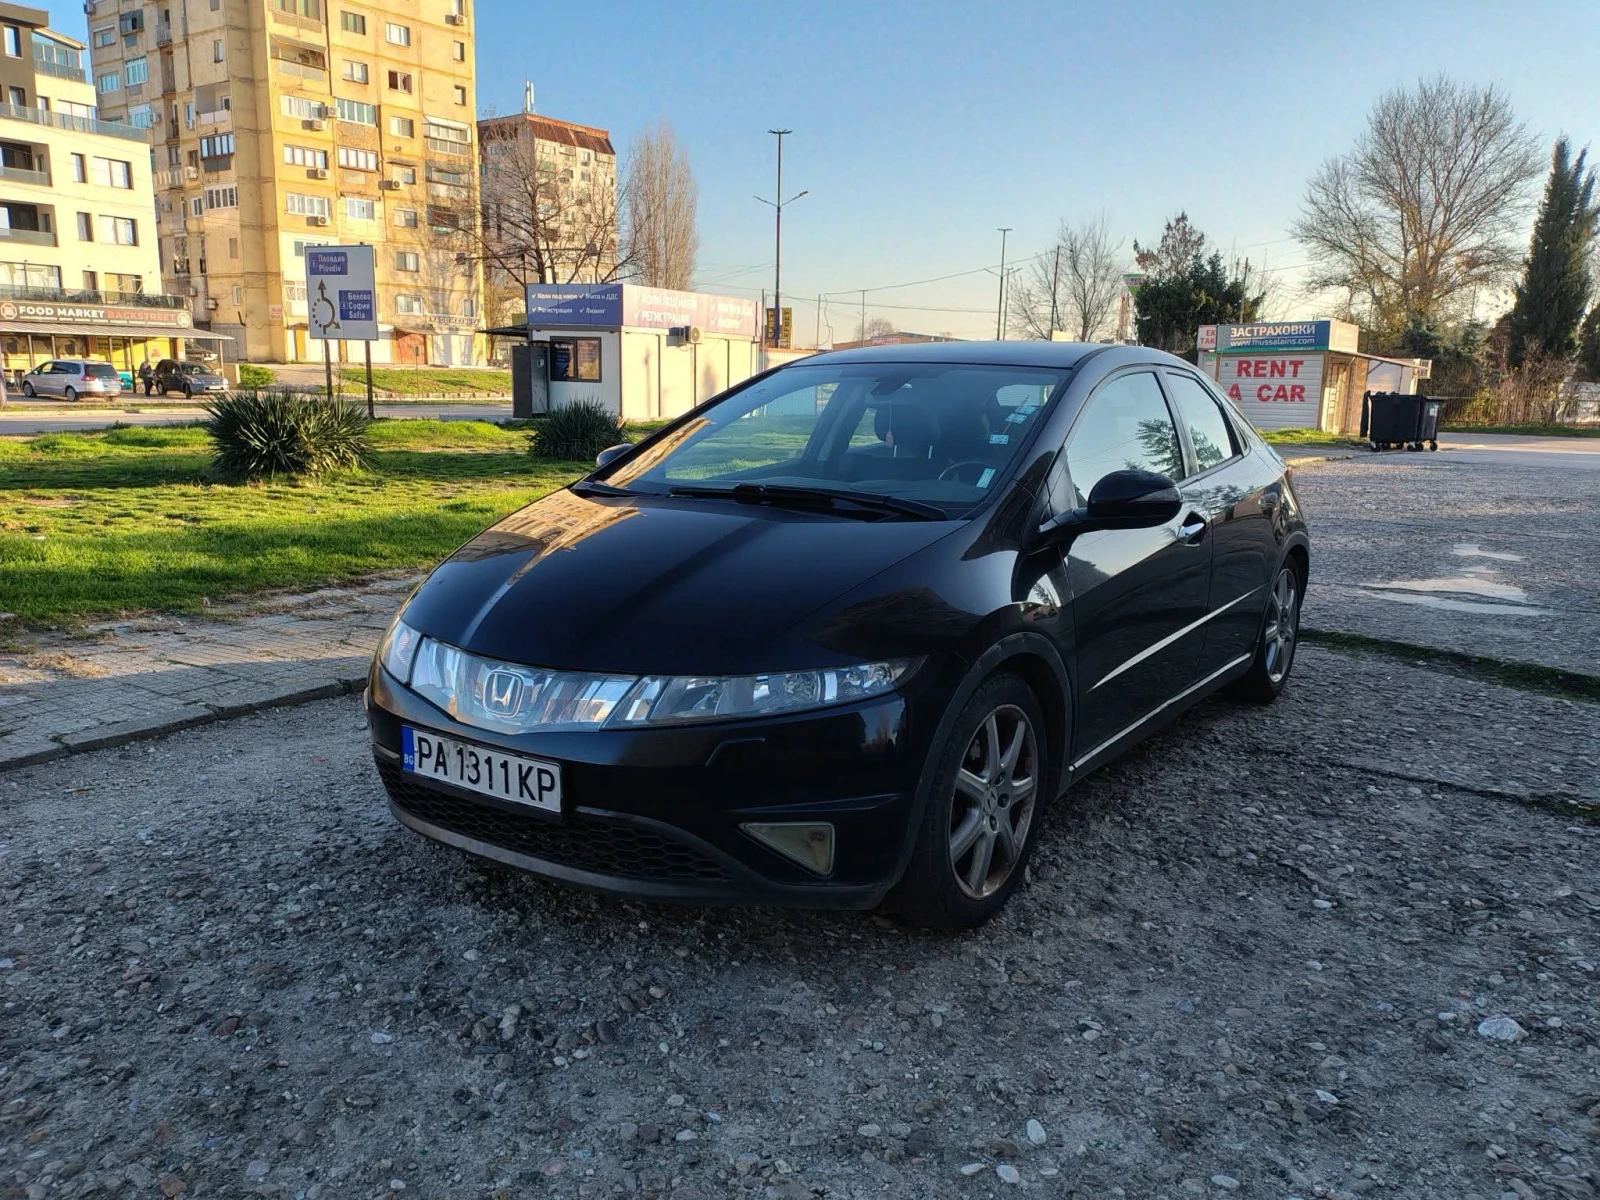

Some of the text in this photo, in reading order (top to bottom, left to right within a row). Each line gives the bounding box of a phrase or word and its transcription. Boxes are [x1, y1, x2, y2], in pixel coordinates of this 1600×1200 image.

[319, 255, 345, 263] Пловдив
[319, 264, 341, 272] Plovdiv
[348, 292, 371, 300] Белово
[348, 302, 370, 310] София
[19, 305, 54, 316] FOOD
[57, 307, 105, 318] MARKET
[107, 310, 176, 322] BACKSTREET
[349, 311, 365, 319] Sofia
[1230, 325, 1316, 338] ЗАСТРАХОВКИ
[1230, 337, 1315, 347] www.mussalains.com
[1237, 360, 1304, 378] RENT
[1228, 383, 1306, 402] A CAR
[403, 753, 414, 765] BG
